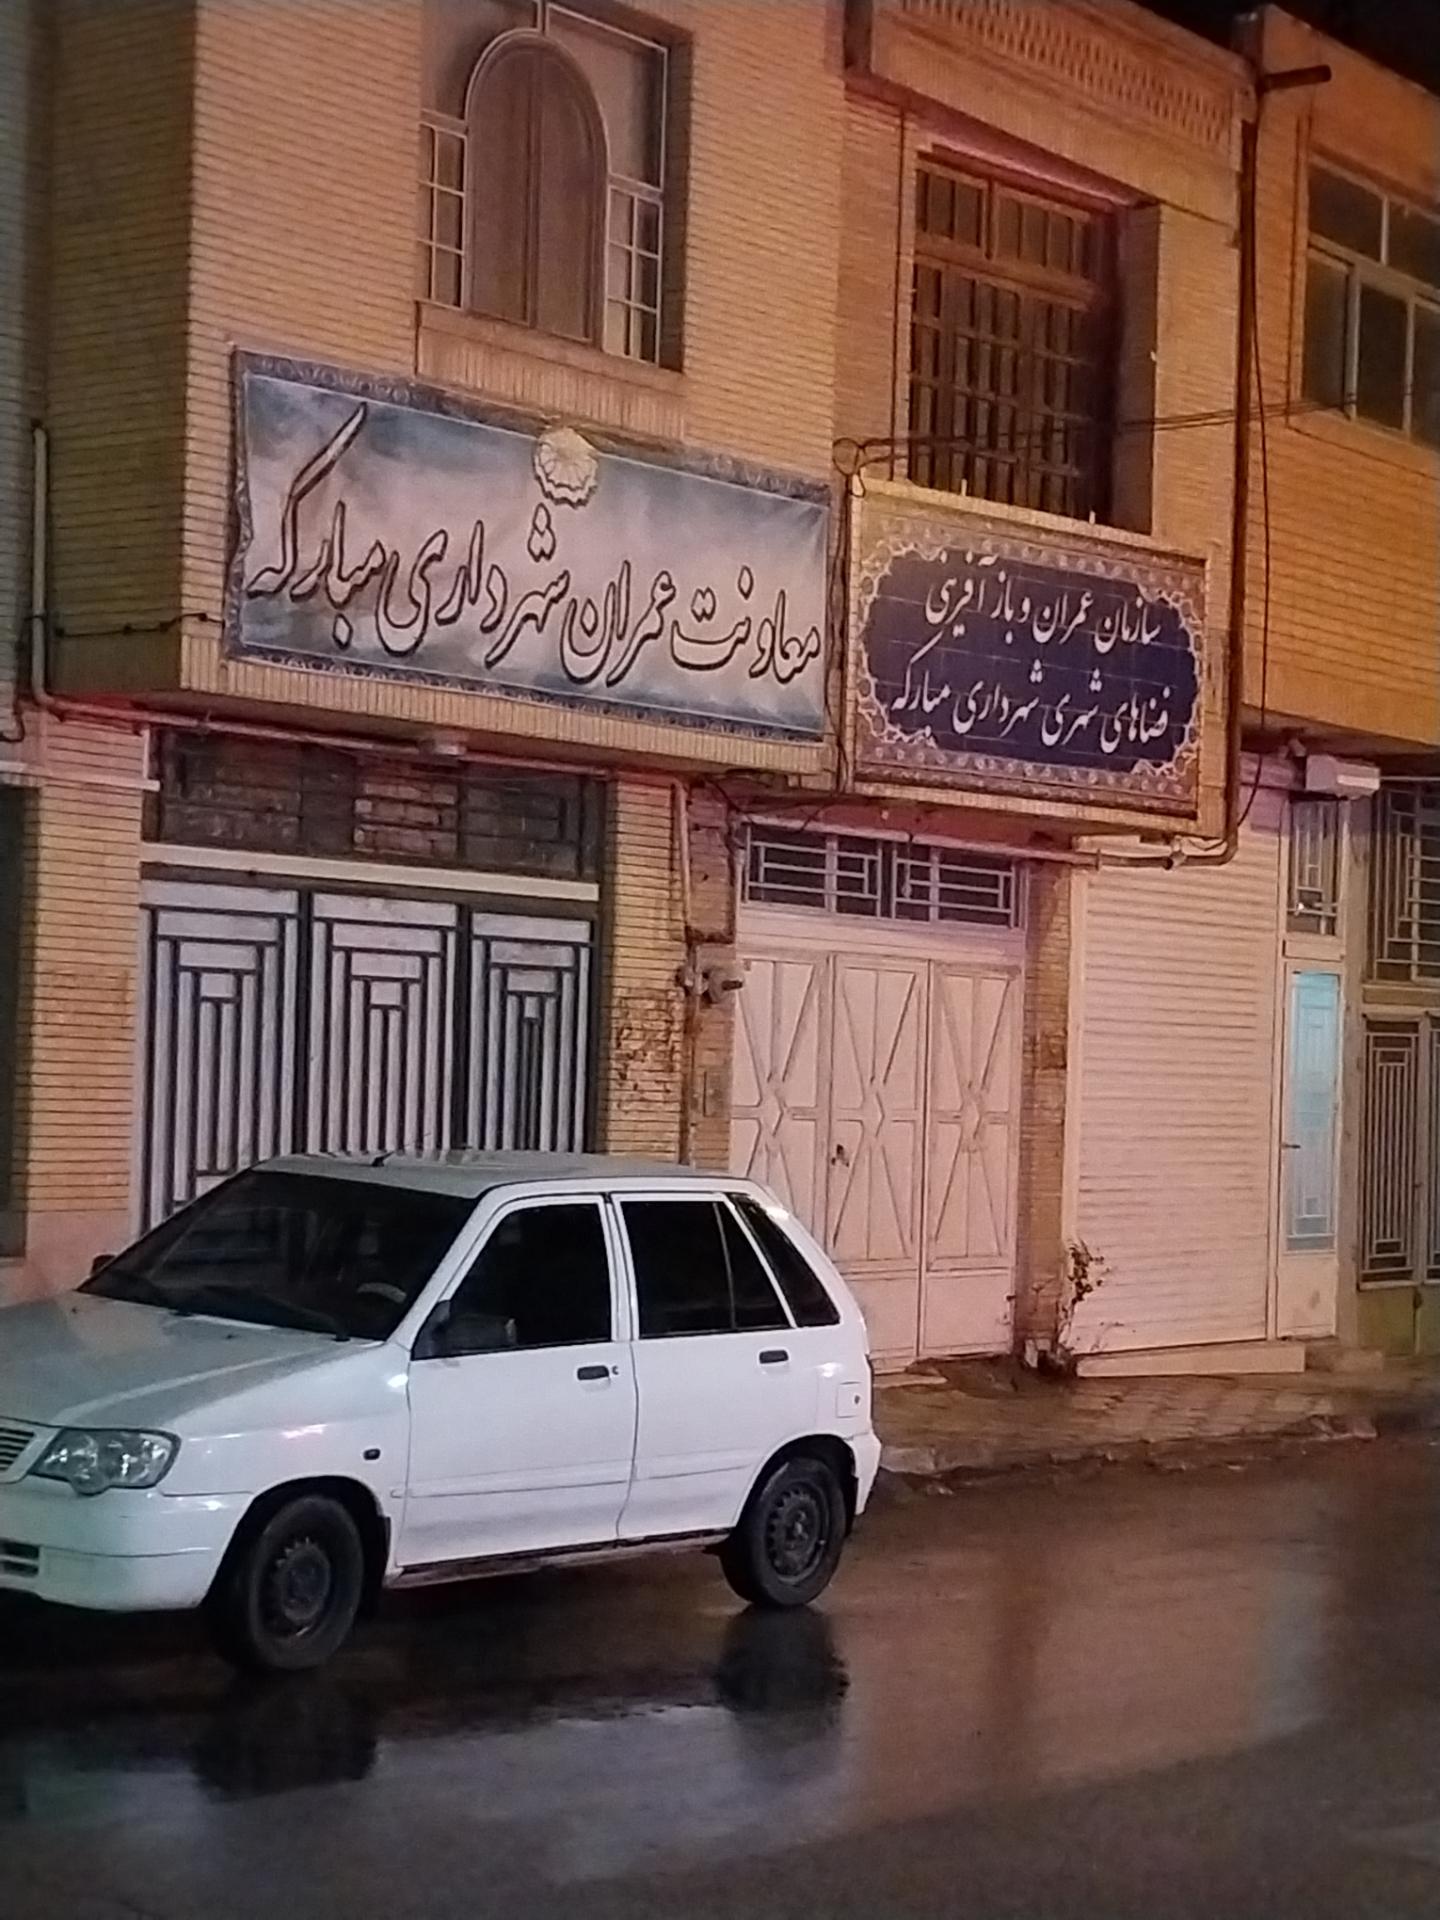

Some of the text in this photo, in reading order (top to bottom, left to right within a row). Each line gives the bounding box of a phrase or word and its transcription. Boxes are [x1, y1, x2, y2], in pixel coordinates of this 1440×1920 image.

[247, 401, 821, 688] معاونت عمران شهرداری مبارکه
[1017, 596, 1031, 624] و
[1032, 591, 1094, 644] عمران
[1093, 595, 1162, 654] سازمان
[890, 630, 1169, 754] فضاهای شهری شهرداری مبارکه
